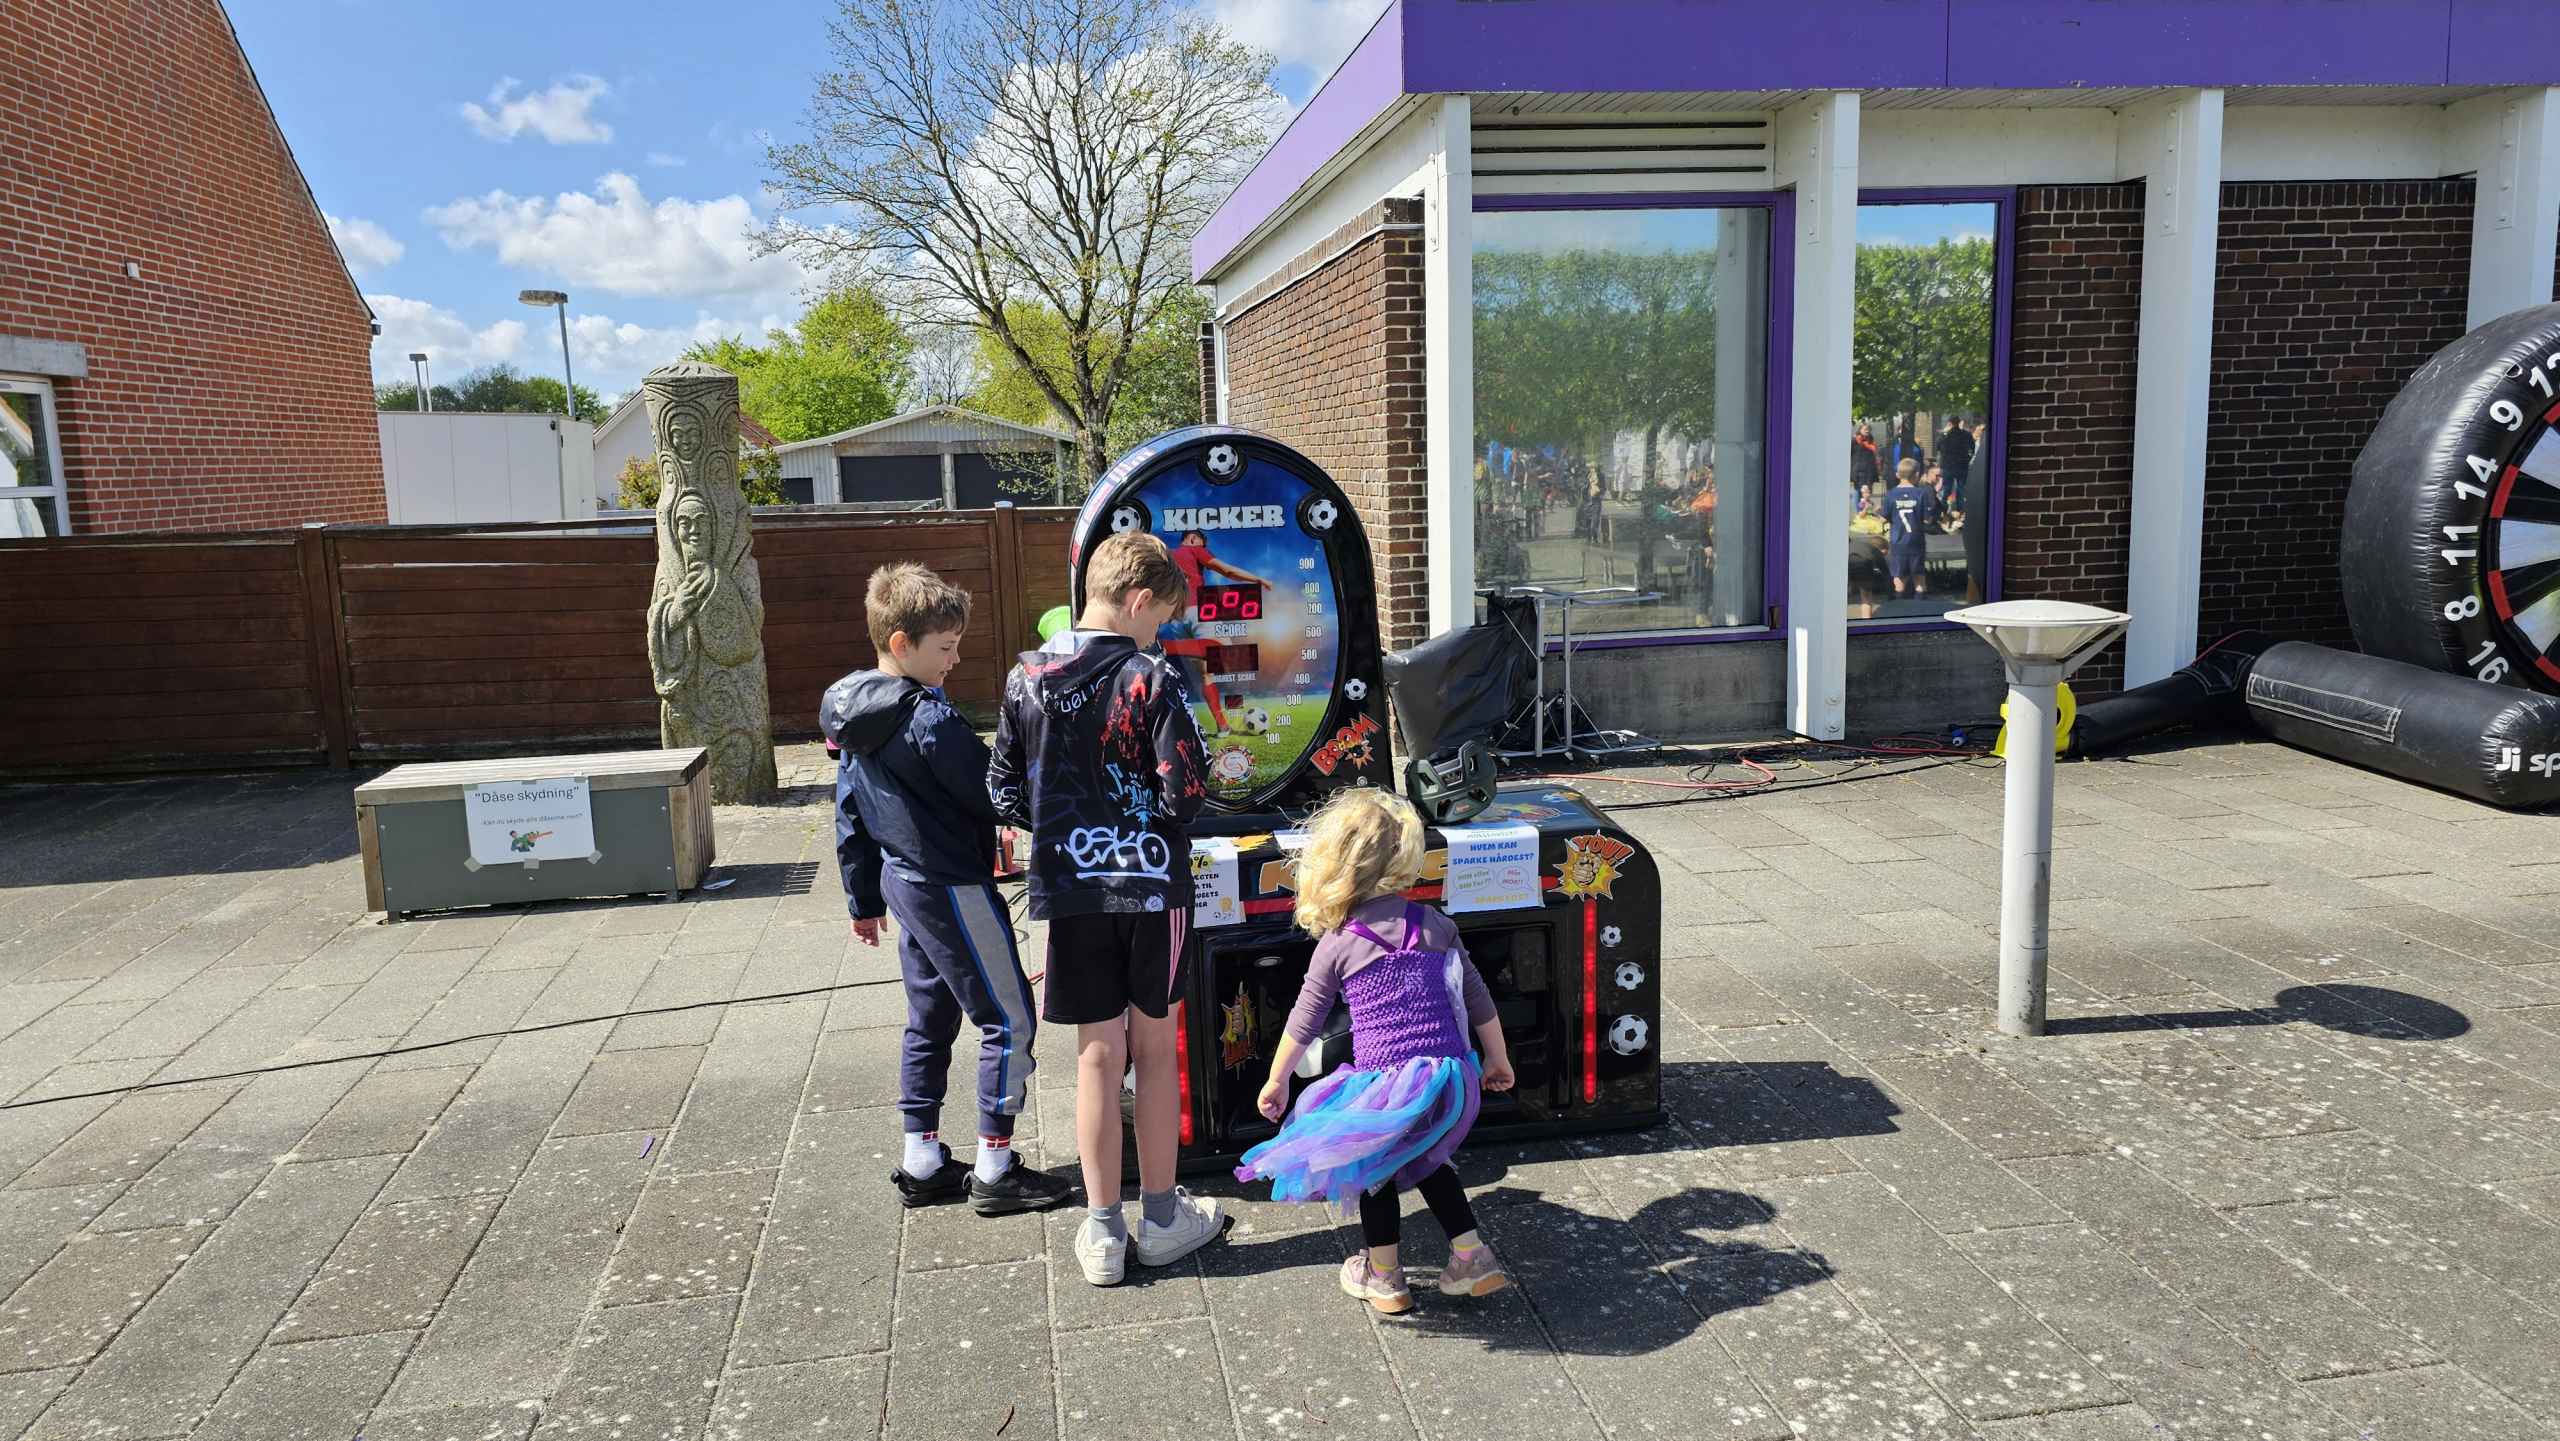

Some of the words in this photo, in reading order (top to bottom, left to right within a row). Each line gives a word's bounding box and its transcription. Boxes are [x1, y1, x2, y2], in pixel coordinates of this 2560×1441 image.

[2490, 400, 2523, 431] 9
[2454, 454, 2498, 500] 14
[1163, 505, 1285, 532] KICKER
[2441, 525, 2479, 566] 11
[1299, 558, 1315, 570] 900
[1307, 602, 1322, 614] 700
[2444, 595, 2480, 622] 8
[1215, 623, 1248, 637] SCORE
[2467, 640, 2509, 684] 16
[1275, 714, 1291, 726] 200
[1265, 732, 1281, 744] 100
[1497, 841, 1518, 850] KAN
[1452, 856, 1488, 866] SPARKE
